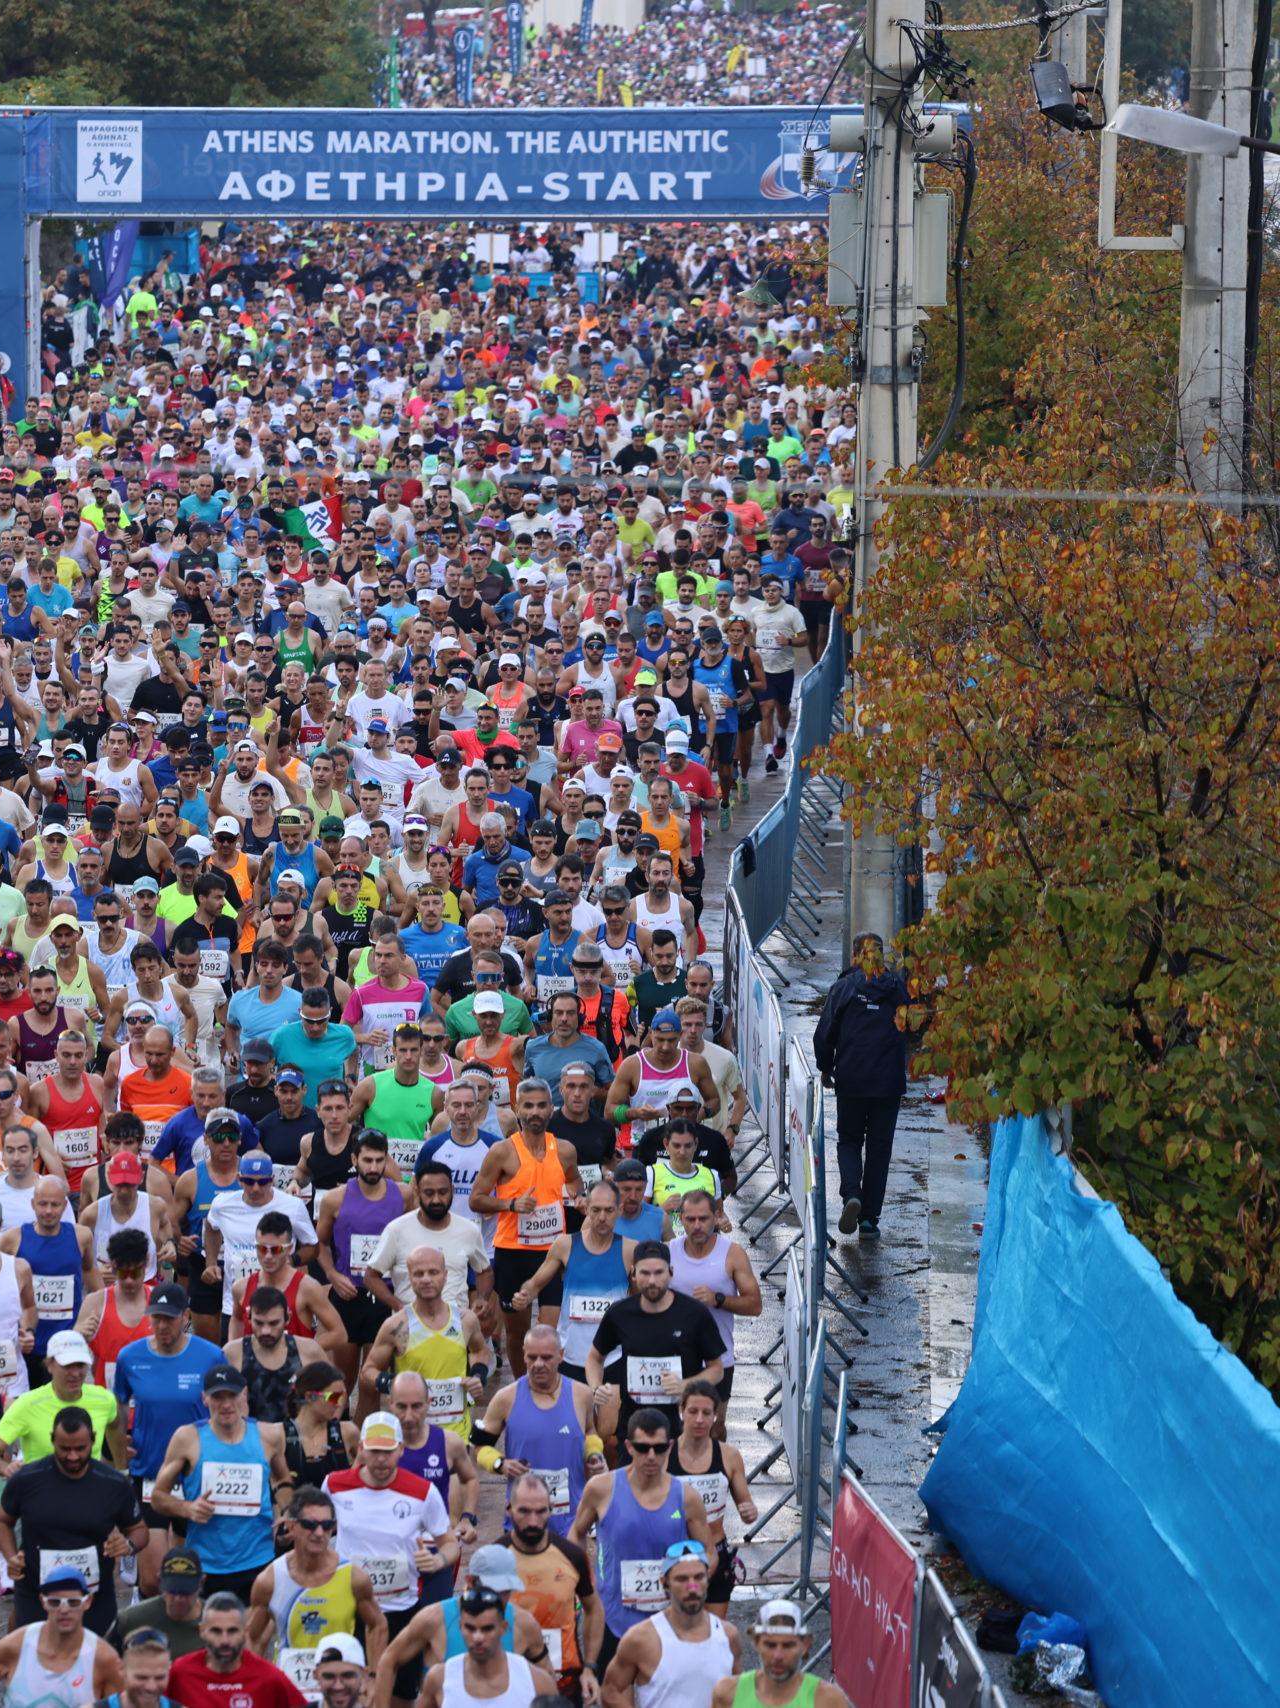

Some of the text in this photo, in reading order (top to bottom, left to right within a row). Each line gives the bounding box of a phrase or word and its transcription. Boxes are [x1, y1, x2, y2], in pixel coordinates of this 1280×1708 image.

[202, 129, 729, 154] ATHENS MARATHON. THE AUTHENTIC
[199, 962, 221, 972] 1592
[65, 1142, 90, 1153] 1605
[525, 1217, 558, 1231] 29000
[36, 1291, 65, 1303] 1621
[581, 1300, 611, 1312] 1322
[215, 1482, 250, 1496] 2222
[832, 1545, 909, 1654] GRAND HYATT
